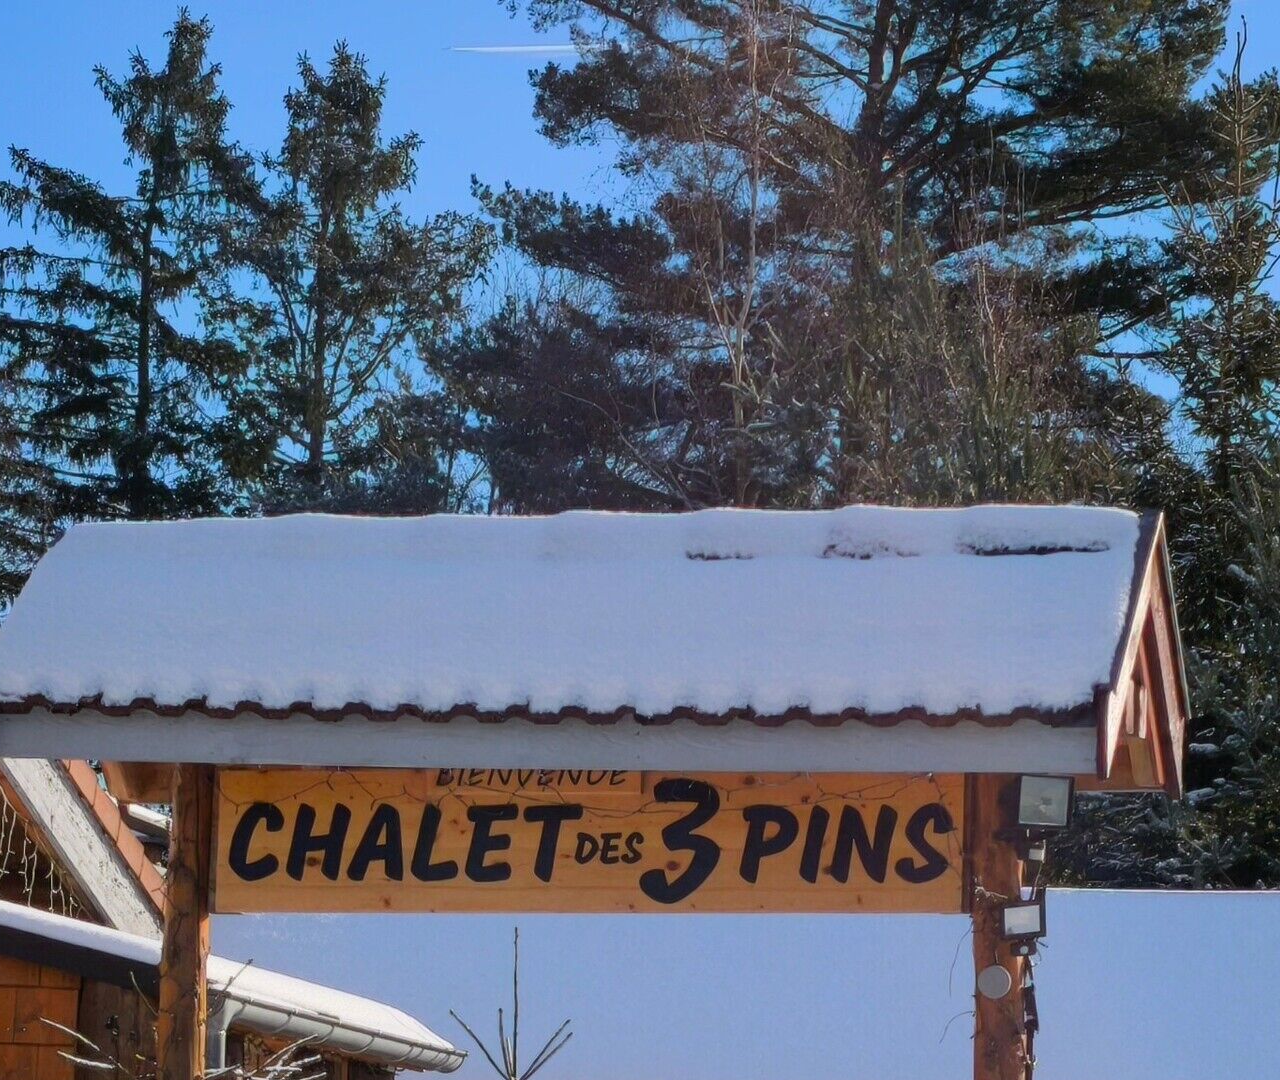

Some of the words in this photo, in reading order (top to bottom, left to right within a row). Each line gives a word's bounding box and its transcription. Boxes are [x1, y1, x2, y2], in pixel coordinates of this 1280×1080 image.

[229, 802, 584, 883] CHALET
[575, 831, 644, 865] DES
[639, 778, 721, 904] 3
[740, 803, 956, 884] PINS
